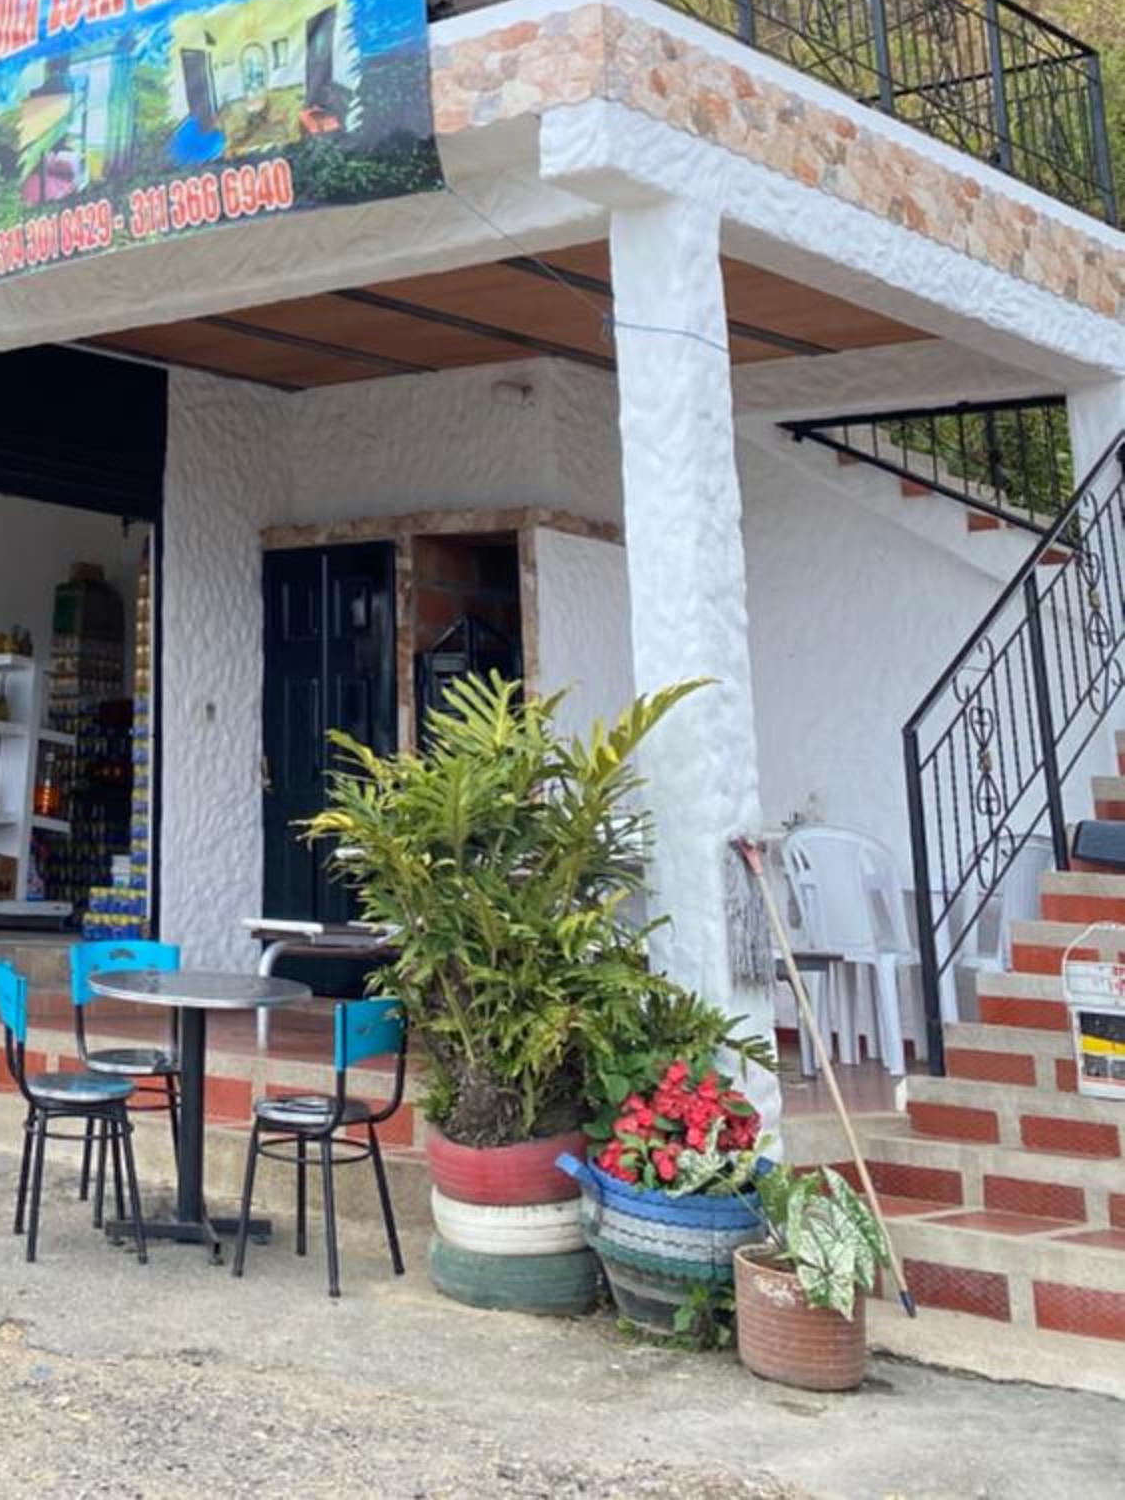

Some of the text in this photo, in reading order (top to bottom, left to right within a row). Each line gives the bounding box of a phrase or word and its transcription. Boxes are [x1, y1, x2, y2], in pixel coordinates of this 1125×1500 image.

[130, 184, 170, 239] 311
[170, 172, 220, 229] 366
[221, 156, 294, 218] 6940
